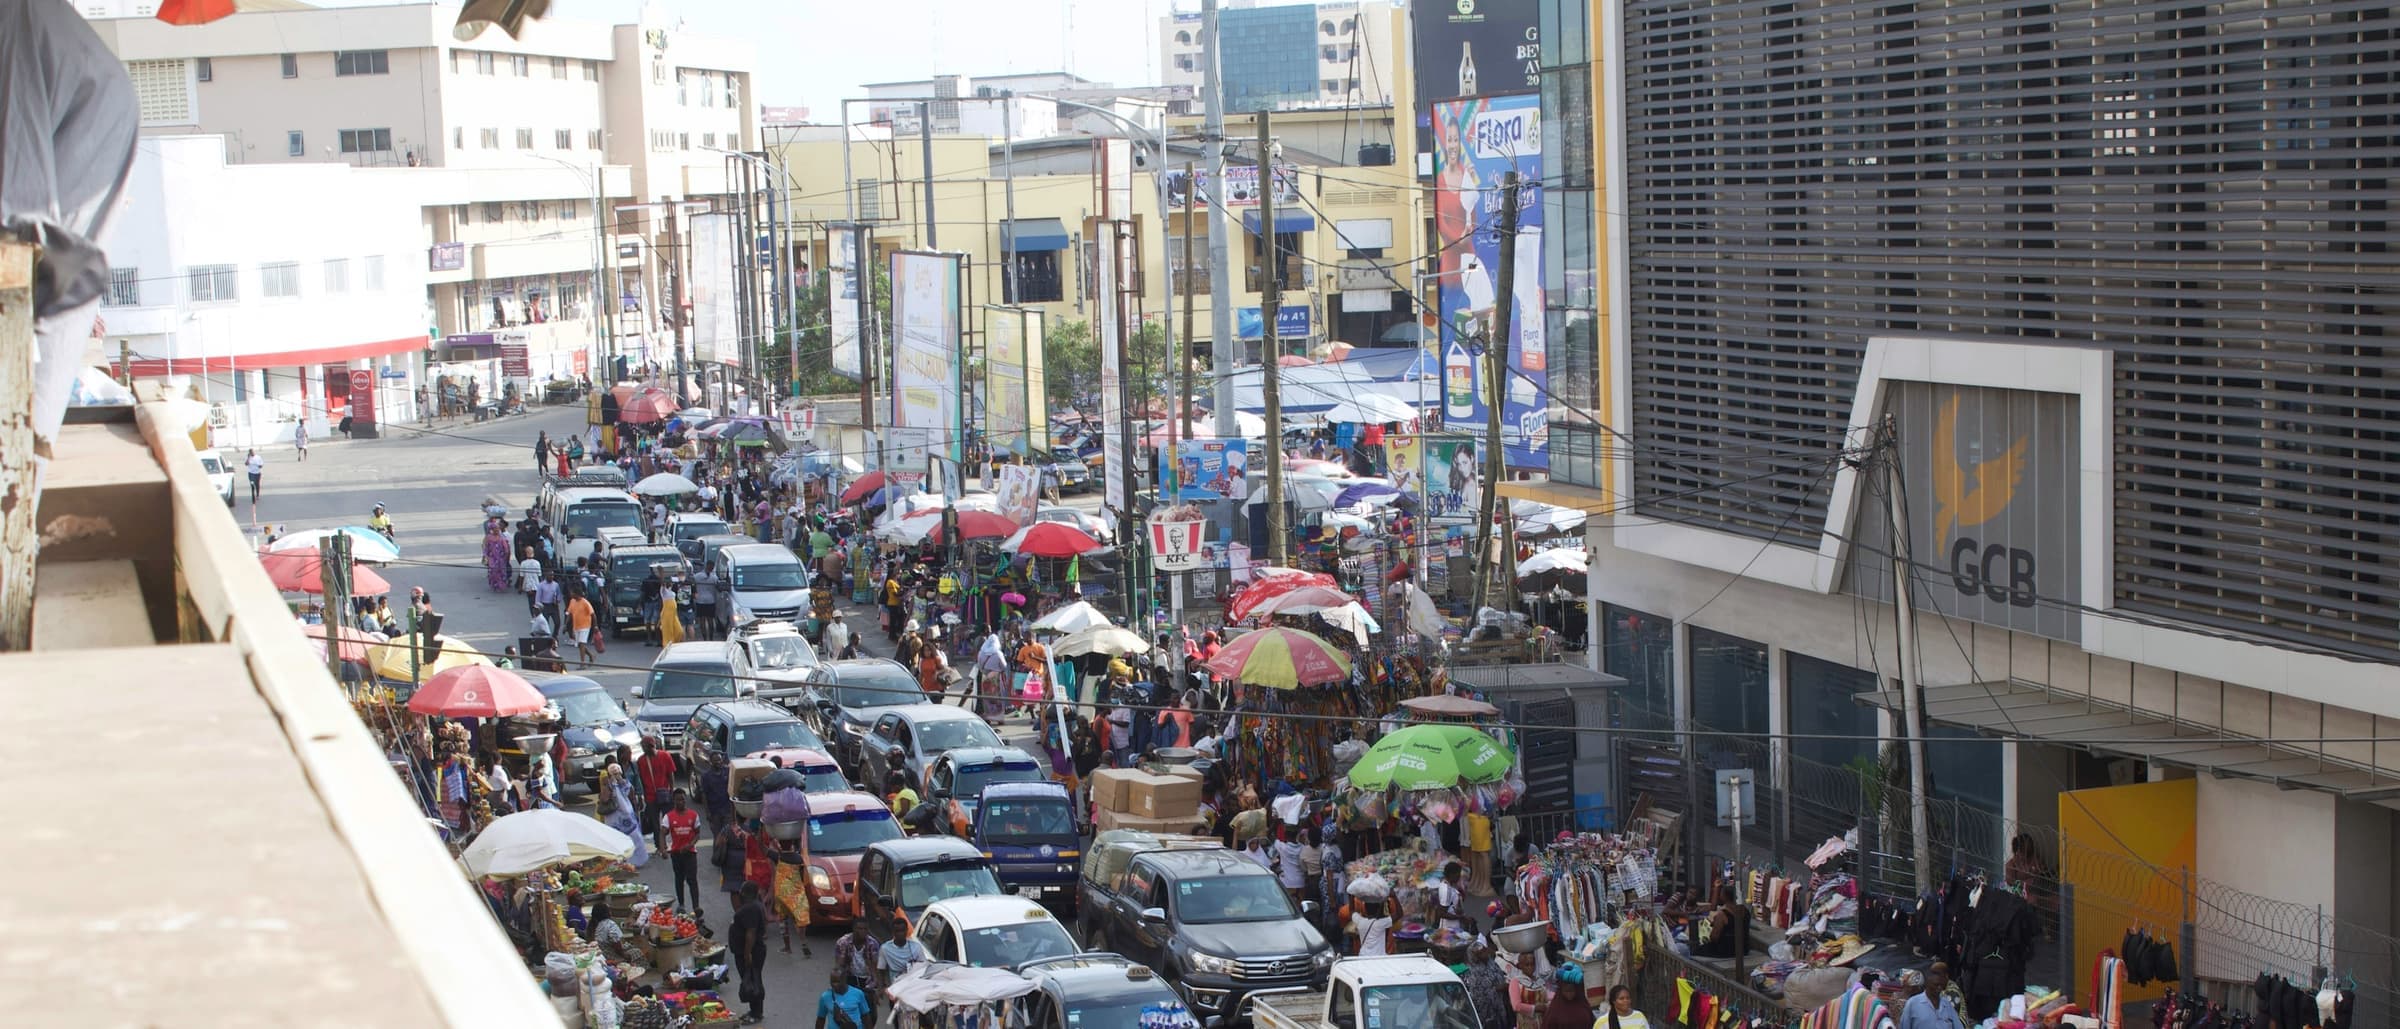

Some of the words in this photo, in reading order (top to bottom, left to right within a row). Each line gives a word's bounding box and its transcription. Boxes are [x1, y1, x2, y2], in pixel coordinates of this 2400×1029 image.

[1525, 26, 1537, 41] G
[1477, 115, 1521, 154] Flora
[1523, 412, 1546, 437] Flora
[1166, 553, 1189, 563] KFC
[1951, 537, 2037, 608] GCB
[1472, 747, 1497, 767] WIN
[1132, 968, 1150, 977] TAXI
